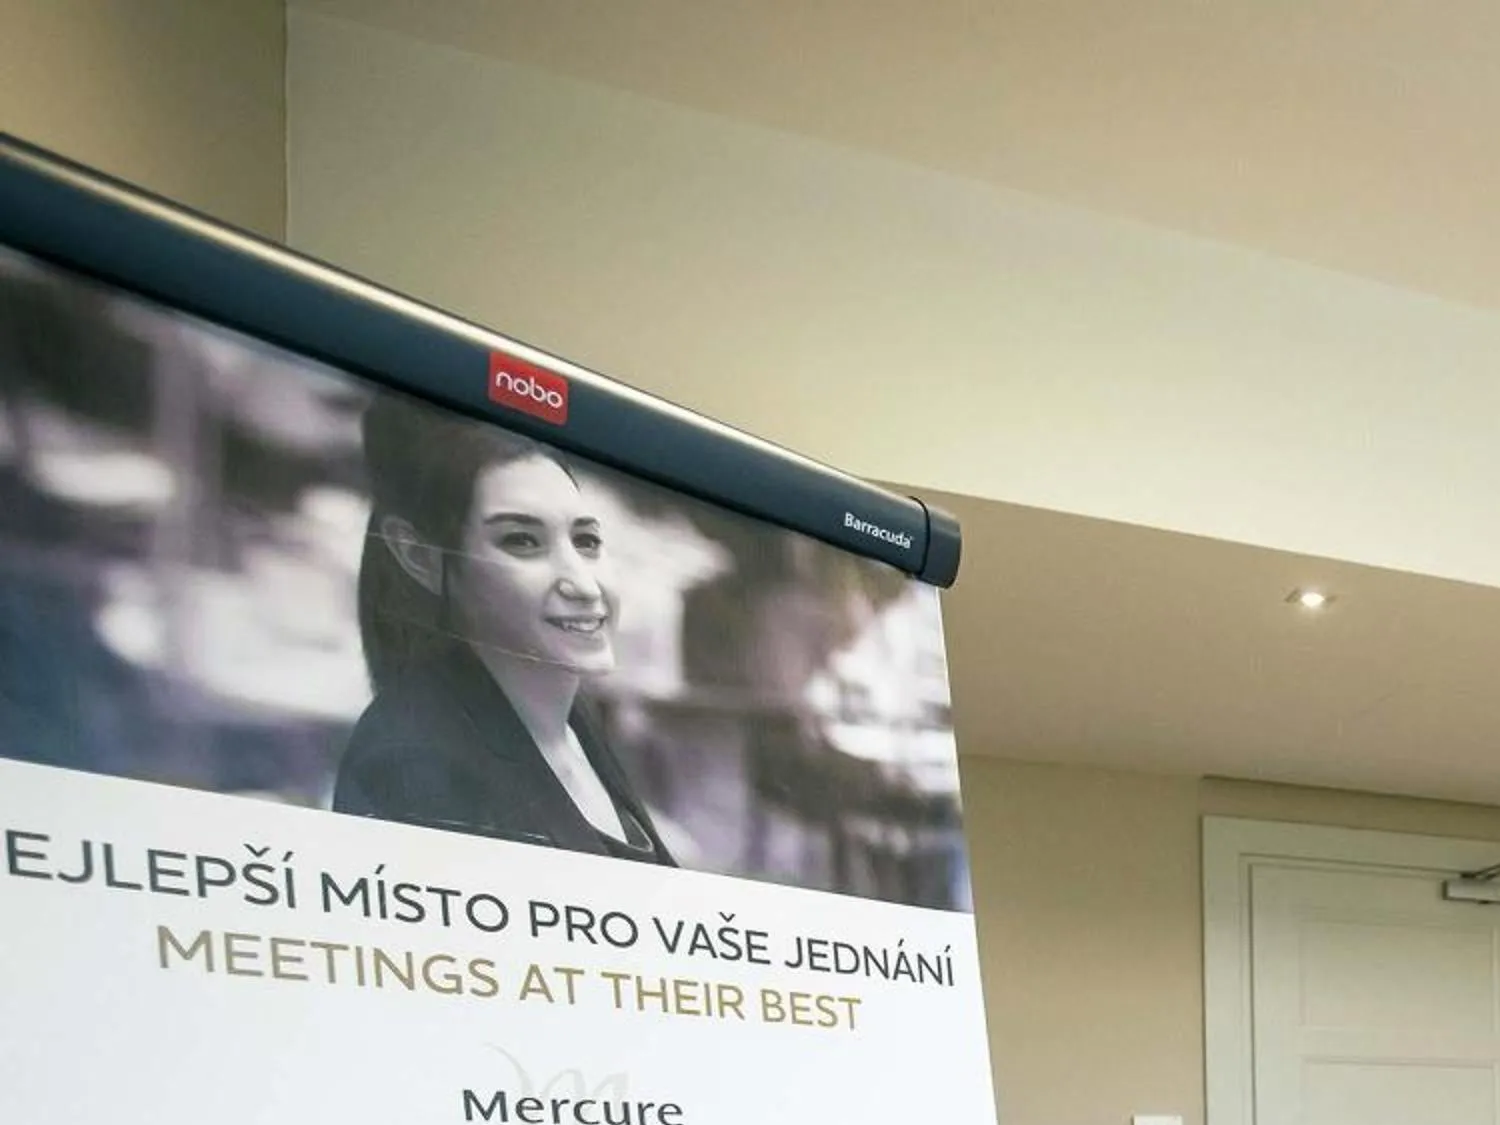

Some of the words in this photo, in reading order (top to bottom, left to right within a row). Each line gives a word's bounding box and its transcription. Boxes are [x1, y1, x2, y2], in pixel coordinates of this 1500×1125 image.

[495, 371, 563, 409] nobo
[844, 511, 912, 549] Barracuda
[5, 828, 297, 909] EJLEPŠÍ
[320, 863, 510, 932] MÍSTO
[527, 899, 639, 949] PRO
[652, 911, 772, 965] VAŠE
[784, 937, 955, 987] JEDNÁNÍ
[156, 924, 500, 998] MEETINGS
[519, 963, 585, 1006] AT
[600, 972, 746, 1021] THEIR
[760, 988, 862, 1031] BEST
